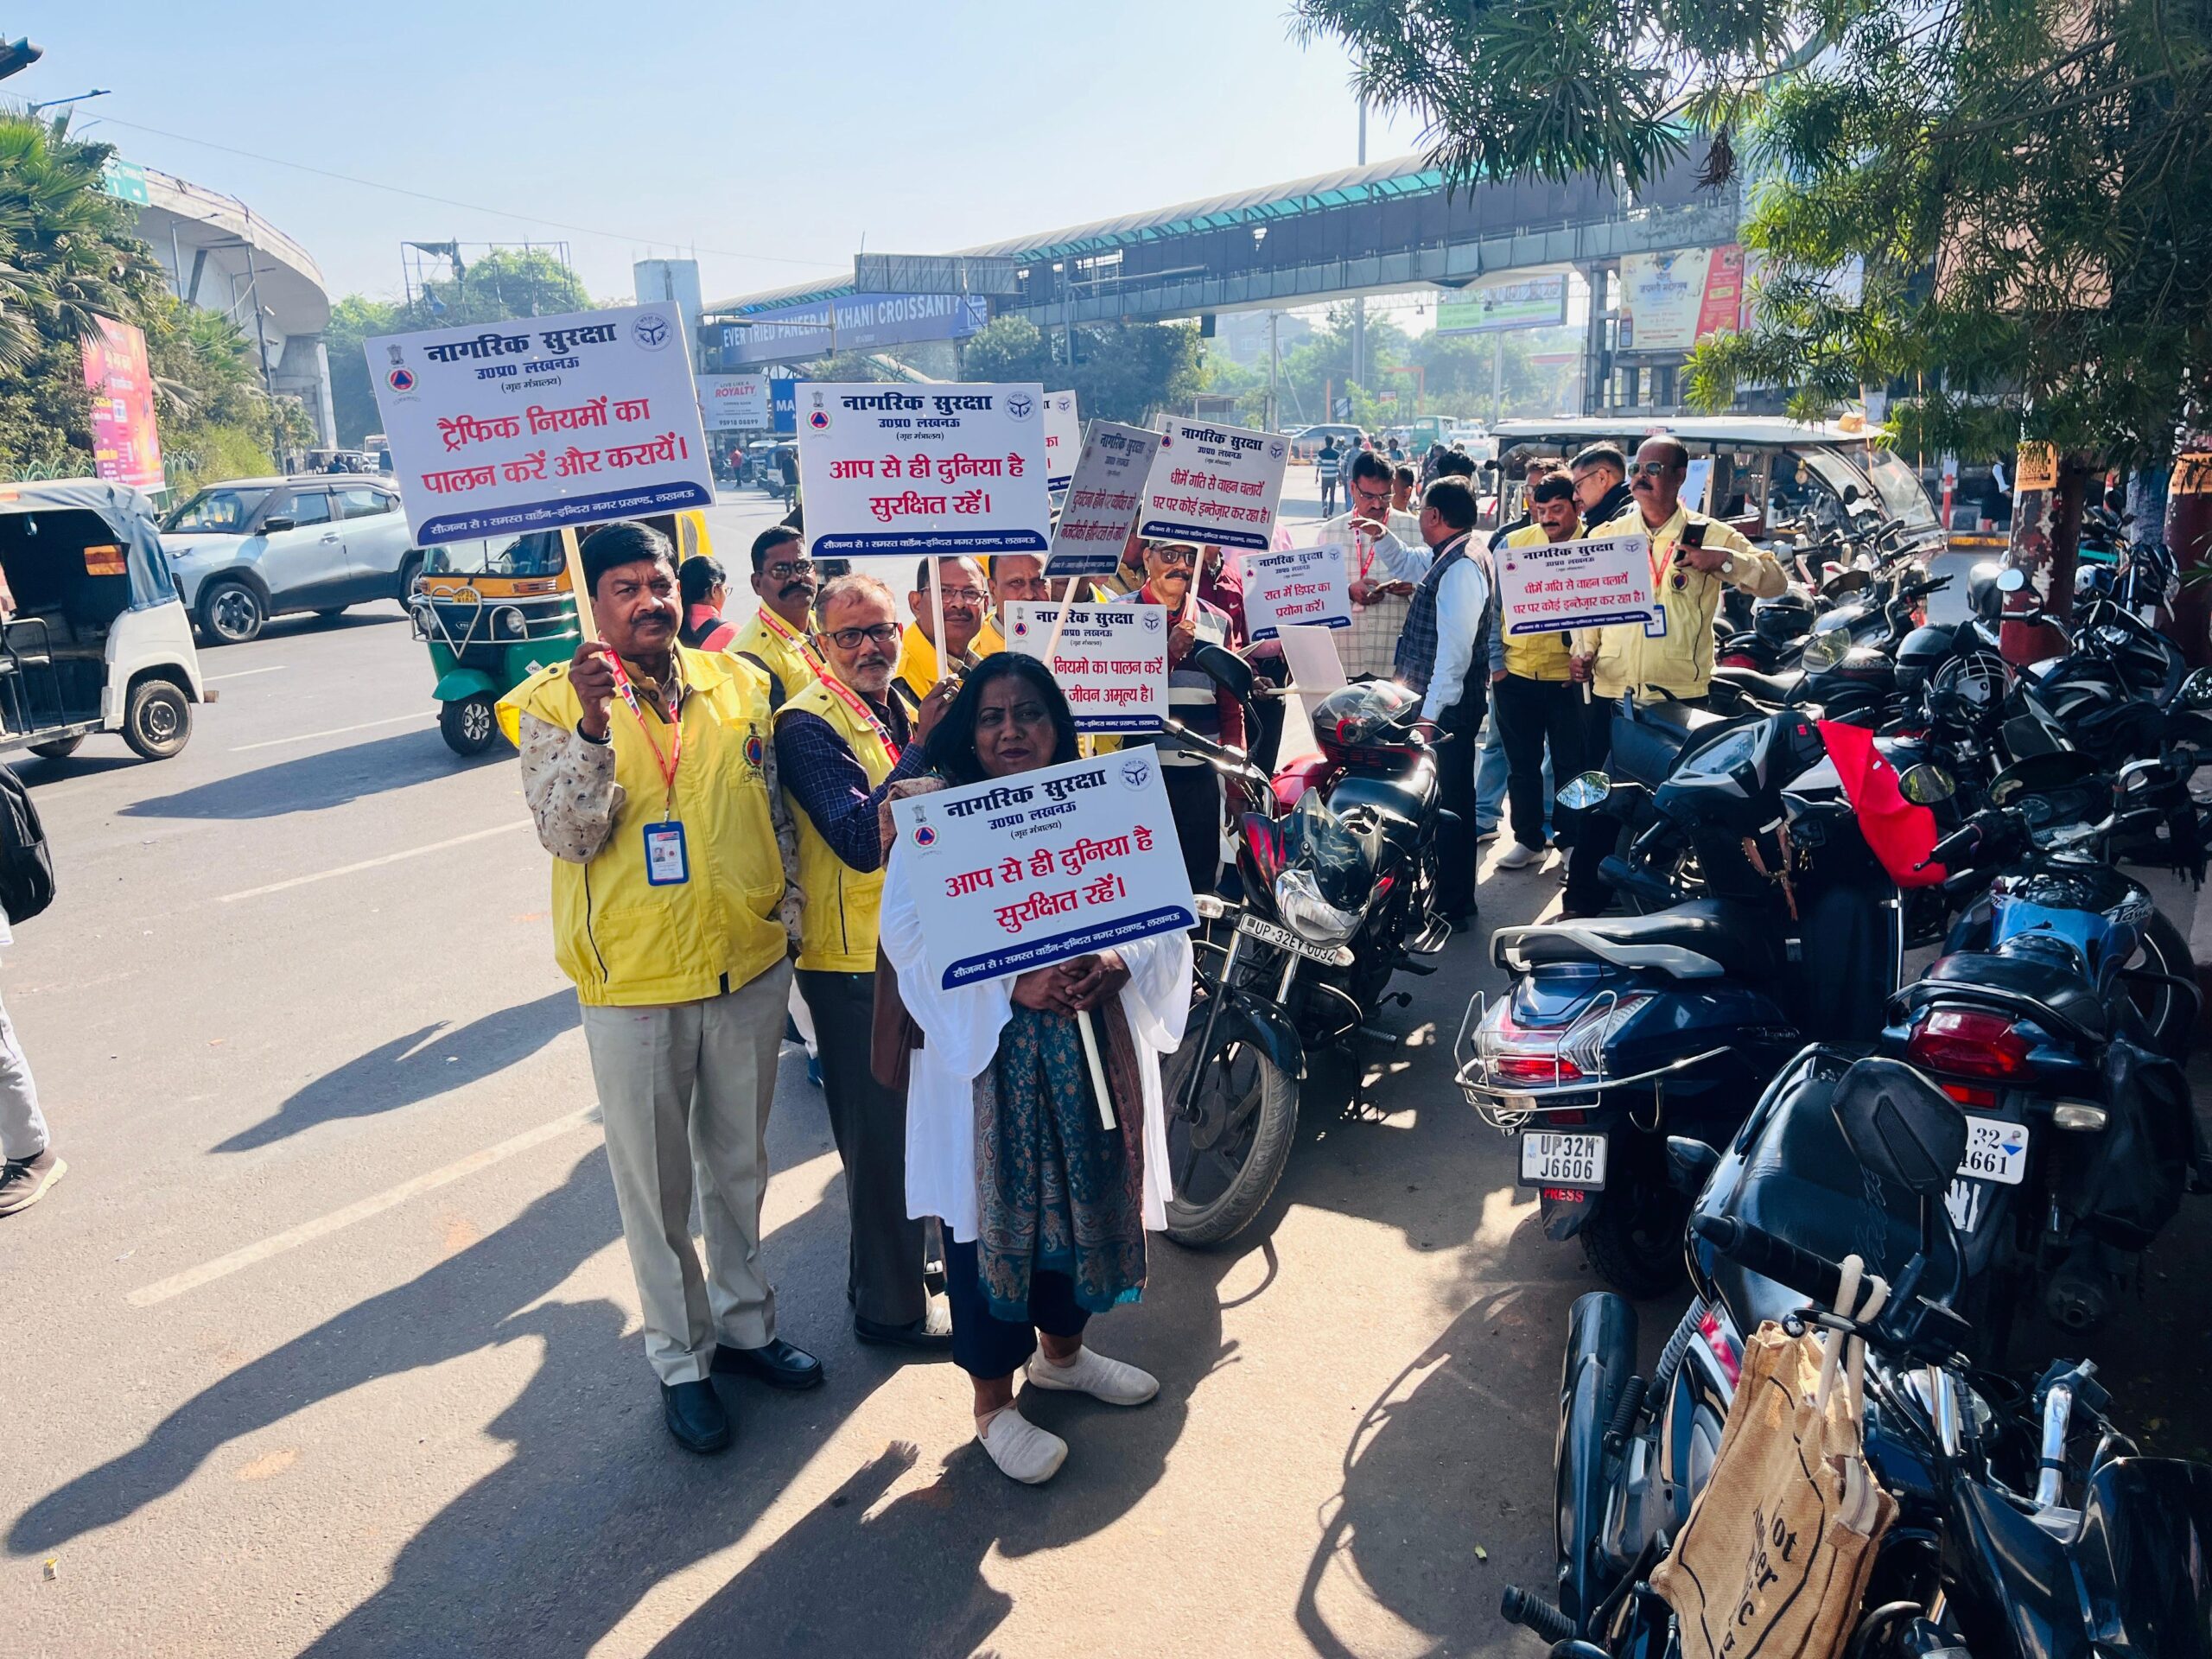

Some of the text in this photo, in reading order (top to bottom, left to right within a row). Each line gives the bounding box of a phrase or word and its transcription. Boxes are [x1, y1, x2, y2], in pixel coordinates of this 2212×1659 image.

[722, 295, 961, 347] EVER TRIED PANEER MKHANI CROISSANT?
[423, 323, 617, 364] नागरिक सुरक्षा
[524, 356, 580, 374] लखनऊ
[524, 375, 562, 391] मंत्रालय)
[715, 385, 755, 397] ROYALTY
[841, 392, 993, 416] नागरिक सुरक्षा
[437, 395, 651, 453] ट्रैफिक नियमों का
[916, 417, 961, 428] लखनऊ
[1181, 427, 1263, 451] नागरिक सुरक्षा
[422, 431, 689, 494] पालन करें और करायें।
[1217, 448, 1242, 459] लखनऊ
[830, 452, 1025, 484] आप से ही दुनिया है
[1171, 469, 1265, 498] धीमें गति से वाहन चलायें
[430, 521, 467, 536] सौजन्य
[470, 516, 480, 531] से
[491, 513, 523, 527] समस्त
[593, 501, 616, 512] नगर
[656, 488, 695, 502] लखनऊ
[869, 488, 991, 522] सुरक्षित रहें।
[1153, 495, 1165, 509] घर
[1166, 497, 1178, 510] पर
[1179, 495, 1198, 515] कोई
[1230, 506, 1246, 520] कर
[1246, 508, 1260, 523] रहा
[1261, 505, 1271, 524] है।
[823, 540, 854, 550] सौजन्य
[855, 540, 863, 549] से
[1005, 536, 1035, 544] लखनऊ
[1523, 542, 1614, 561] नागरिक सुरक्षा
[1258, 551, 1323, 567] नागरिक सुरक्षा
[1264, 582, 1331, 601] रात में डिपर का
[1524, 571, 1629, 594] धीमें गति से वाहन चलायें
[1275, 598, 1325, 618] प्रयोग करें।
[1513, 604, 1526, 614] घर
[1527, 602, 1540, 612] पर
[1541, 598, 1561, 613] कोई
[1599, 594, 1615, 605] कर
[1617, 594, 1632, 604] रहा
[1095, 613, 1134, 628] सुरक्षा
[1092, 659, 1108, 674] का
[1111, 660, 1141, 675] पालन
[1144, 657, 1163, 675] करें
[1069, 684, 1154, 707] जीवन अमूल्य है।
[944, 769, 1107, 819] नागरिक सुरक्षा
[1028, 801, 1077, 821] लखनऊ
[1029, 819, 1062, 835] मंत्रालय)
[945, 825, 1154, 898] आप से ही दुनिया है
[994, 873, 1126, 933] सुरक्षित रहें।
[1255, 922, 1271, 936] UP
[953, 963, 986, 979] सौजन्य
[988, 958, 997, 969] से
[1005, 950, 1034, 965] समस्त
[1093, 929, 1115, 942] नगर
[1147, 912, 1181, 927] लखनऊ
[1974, 1128, 2000, 1149] 32
[1540, 1158, 1593, 1179] J6606
[1543, 1187, 1585, 1203] PRESS
